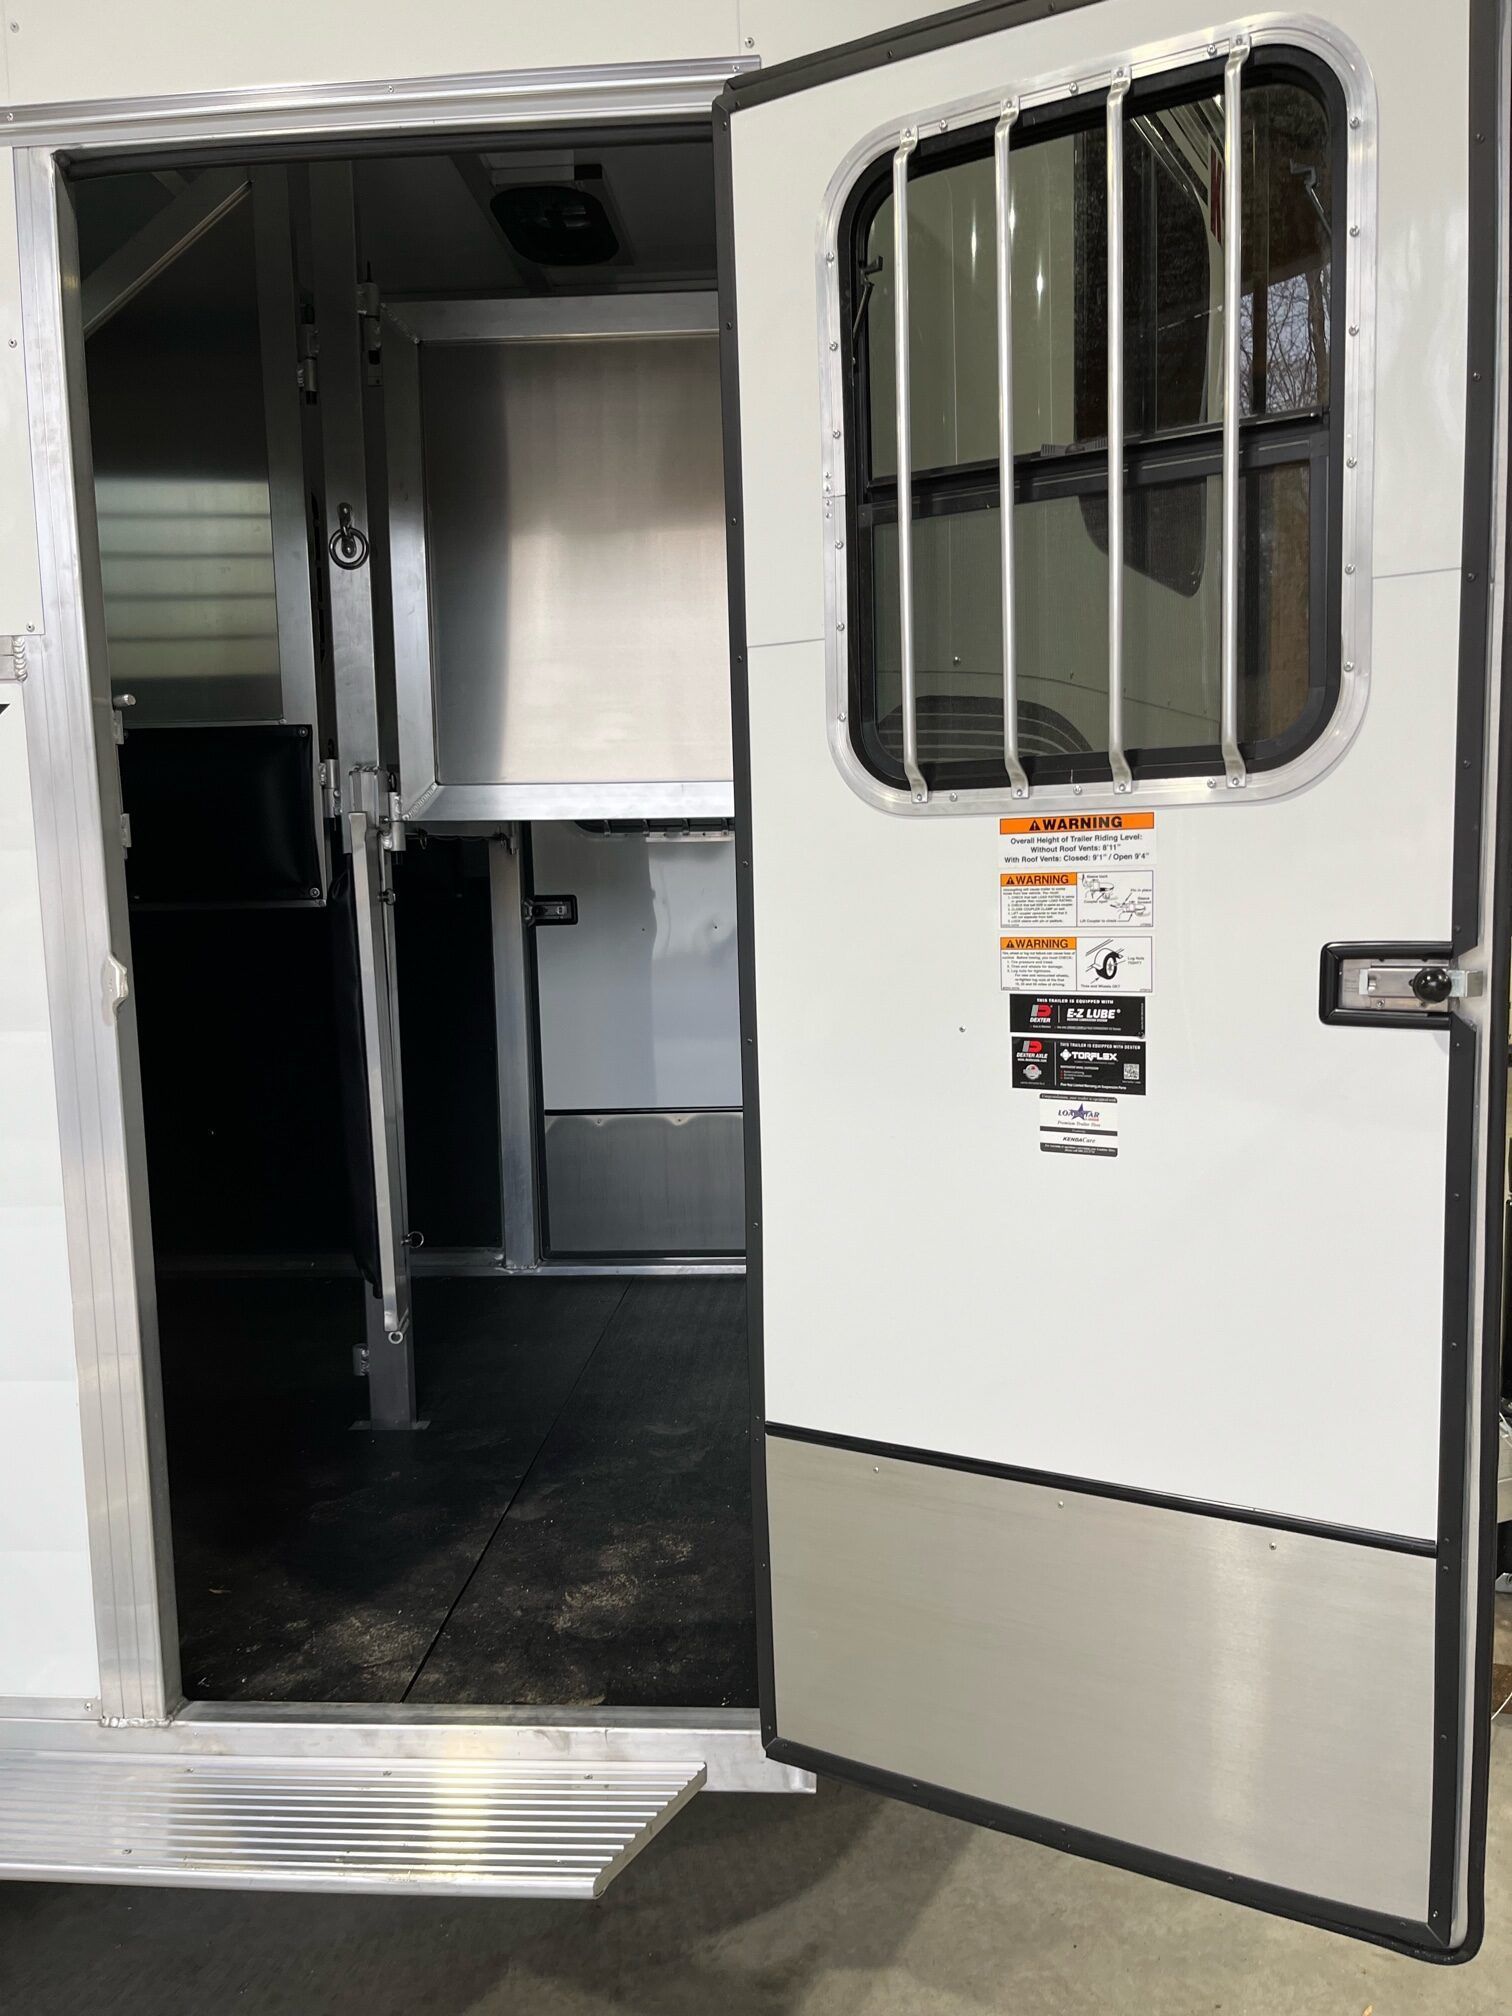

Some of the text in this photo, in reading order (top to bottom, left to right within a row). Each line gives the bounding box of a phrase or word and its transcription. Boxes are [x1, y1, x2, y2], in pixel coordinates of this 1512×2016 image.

[1042, 816, 1122, 830] WARNING
[1036, 836, 1060, 845] Height
[1094, 834, 1118, 842] Riding
[1016, 875, 1069, 884] WARNING
[1016, 939, 1068, 948] WARNING
[1067, 1008, 1084, 1018] E-Z
[1071, 1051, 1117, 1061] TORFLEX
